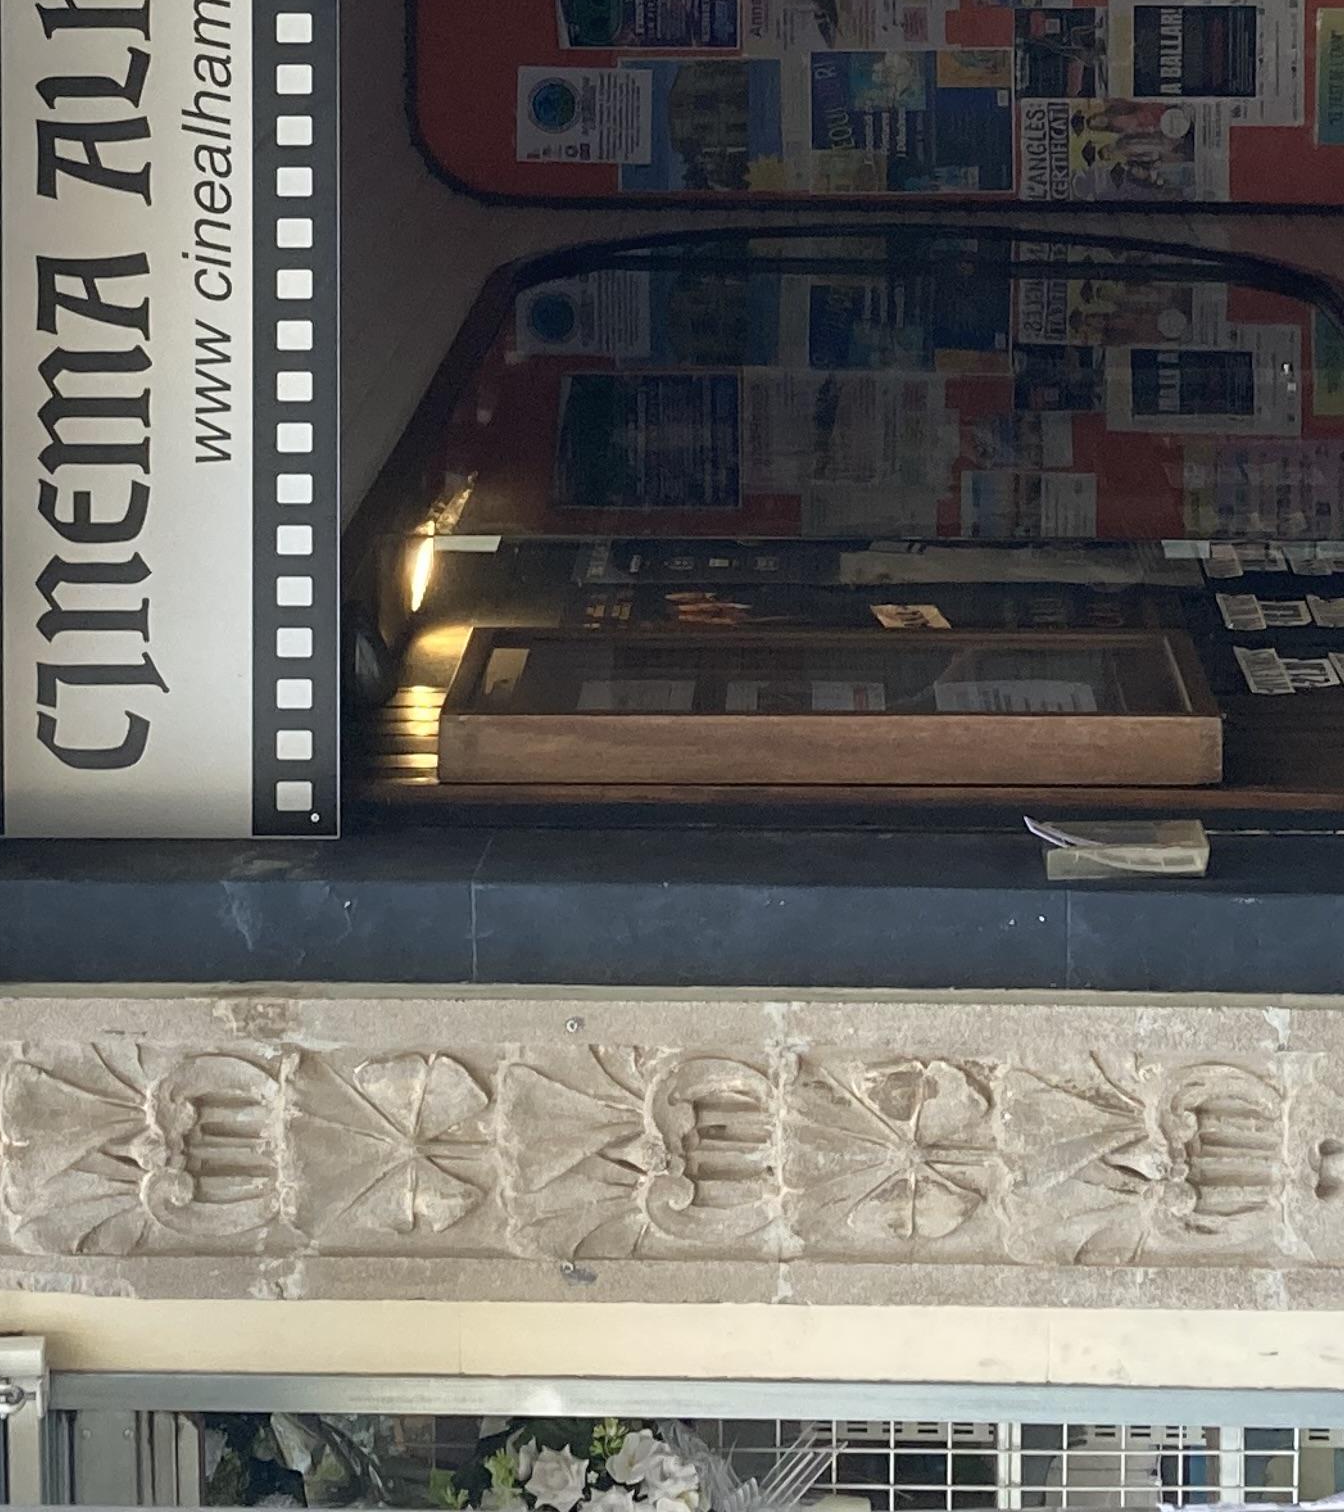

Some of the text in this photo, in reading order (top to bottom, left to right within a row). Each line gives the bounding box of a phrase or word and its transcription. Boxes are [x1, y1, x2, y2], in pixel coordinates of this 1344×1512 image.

[1160, 7, 1183, 94] A BALLAR!
[190, 318, 234, 466] www
[30, 252, 170, 772] CINEMA
